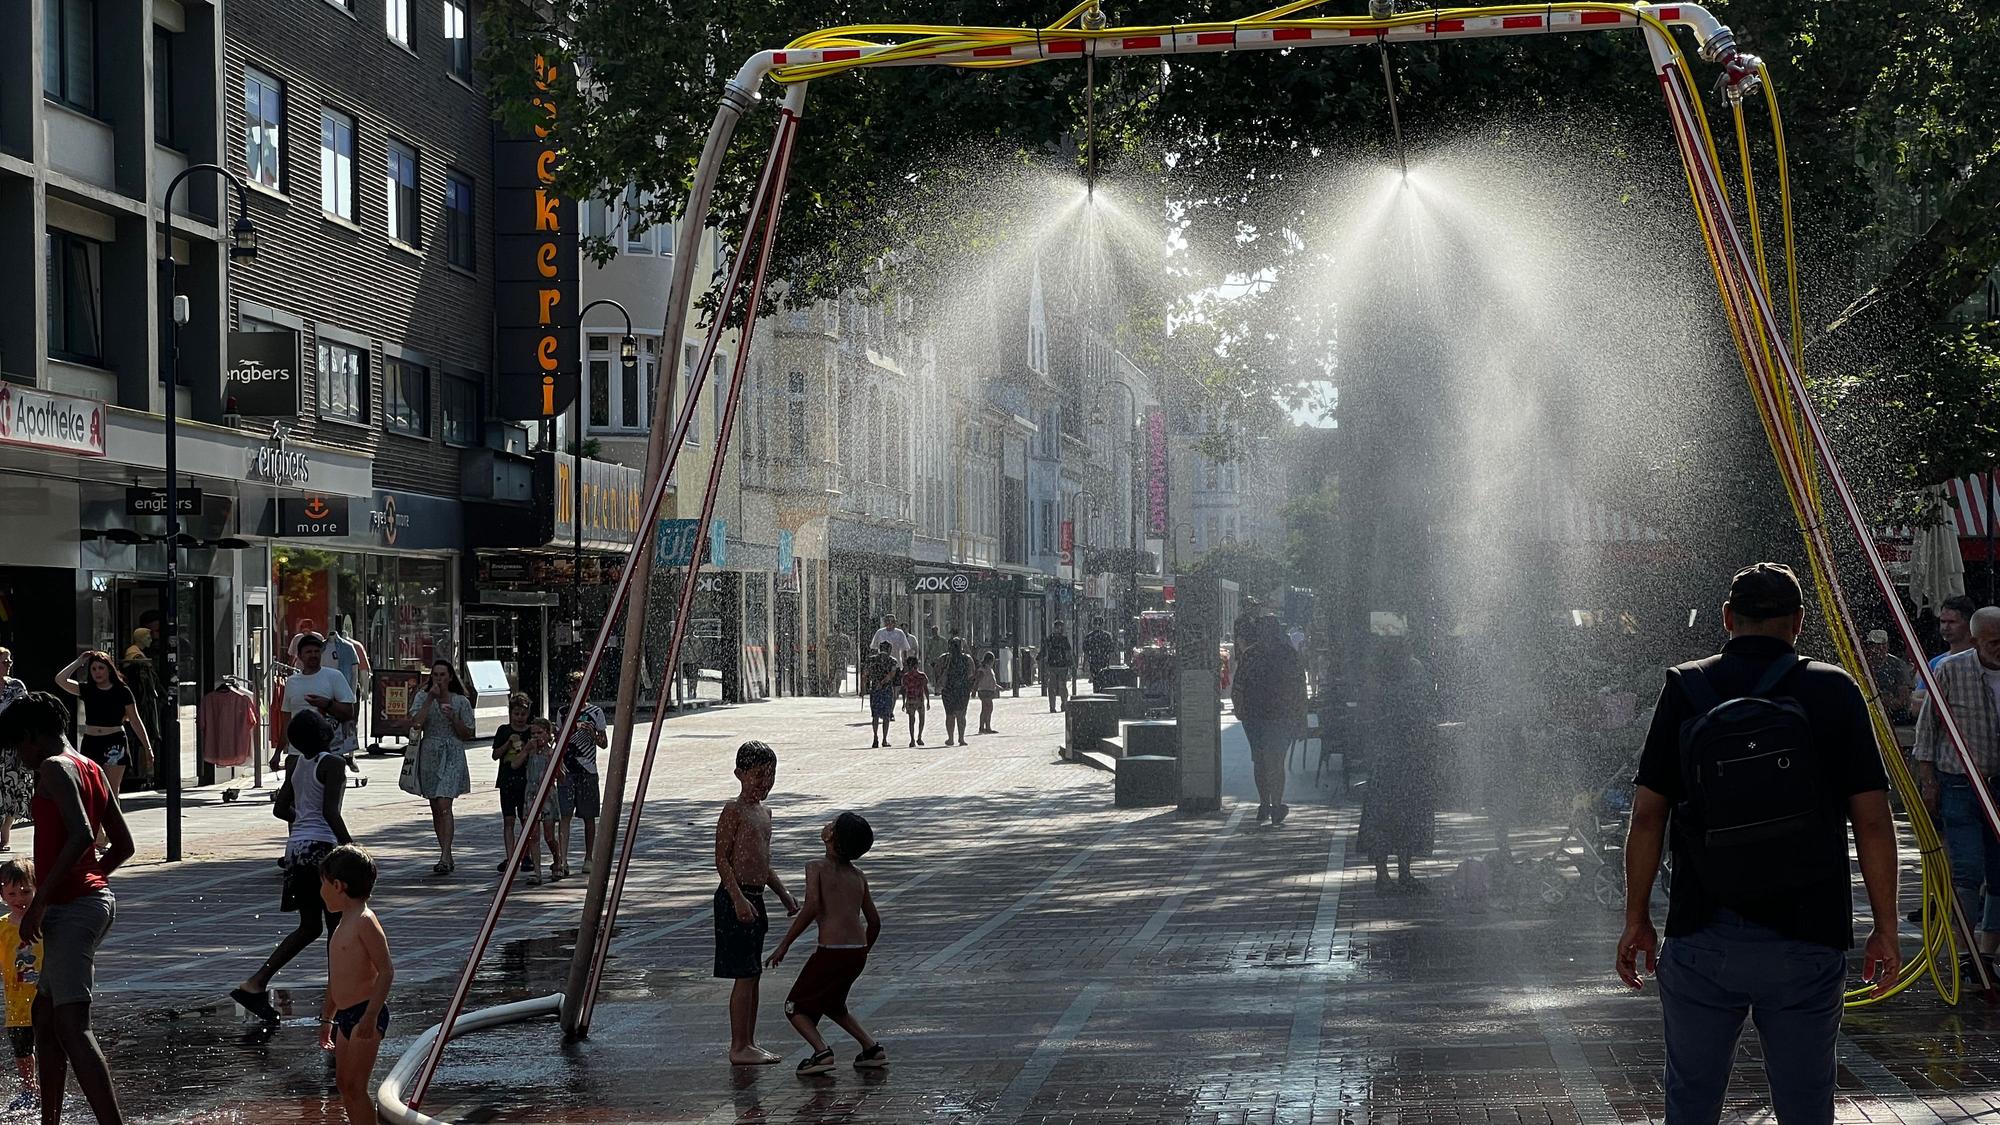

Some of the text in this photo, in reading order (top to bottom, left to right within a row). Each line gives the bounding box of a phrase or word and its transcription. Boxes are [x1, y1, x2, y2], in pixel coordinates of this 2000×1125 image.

[226, 366, 290, 384] ngbers
[16, 396, 85, 442] Apotheke
[297, 523, 337, 534] more
[914, 576, 951, 591] AOK
